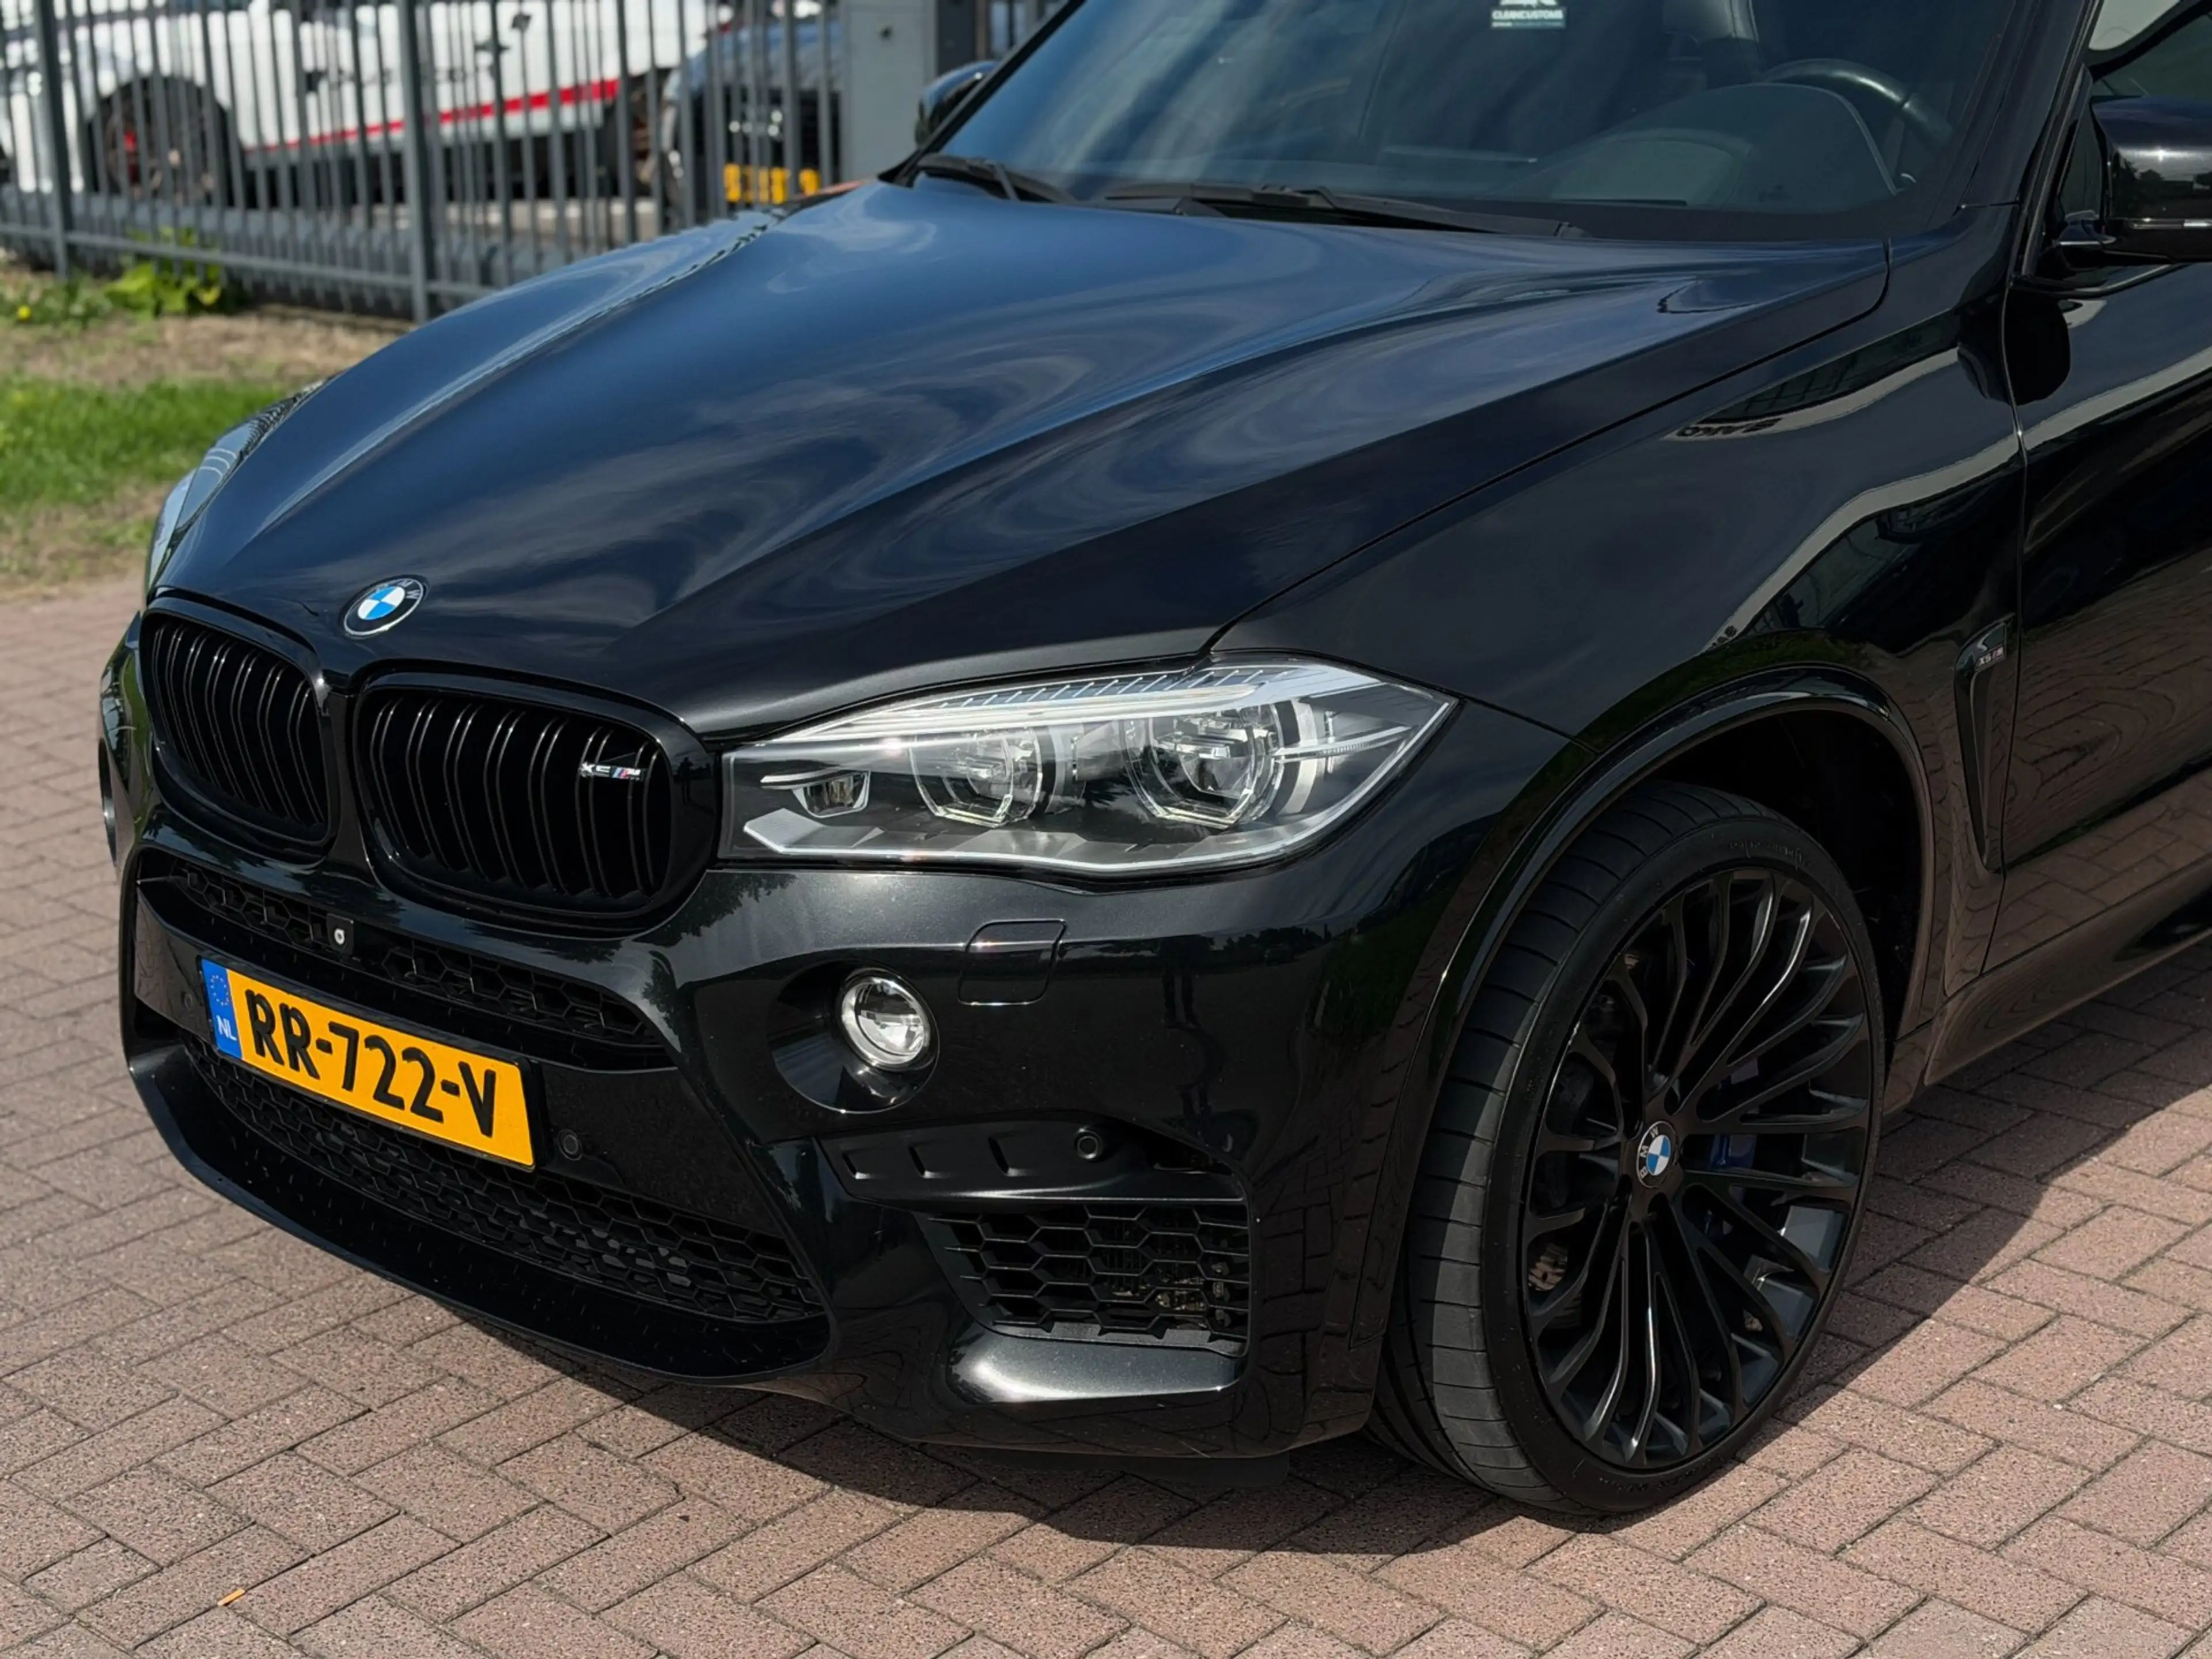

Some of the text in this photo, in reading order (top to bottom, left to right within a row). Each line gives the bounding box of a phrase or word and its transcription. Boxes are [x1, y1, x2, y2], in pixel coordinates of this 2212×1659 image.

[218, 1017, 237, 1041] NL
[245, 988, 496, 1138] RR-722-V
[1639, 1126, 1659, 1179] BMW
